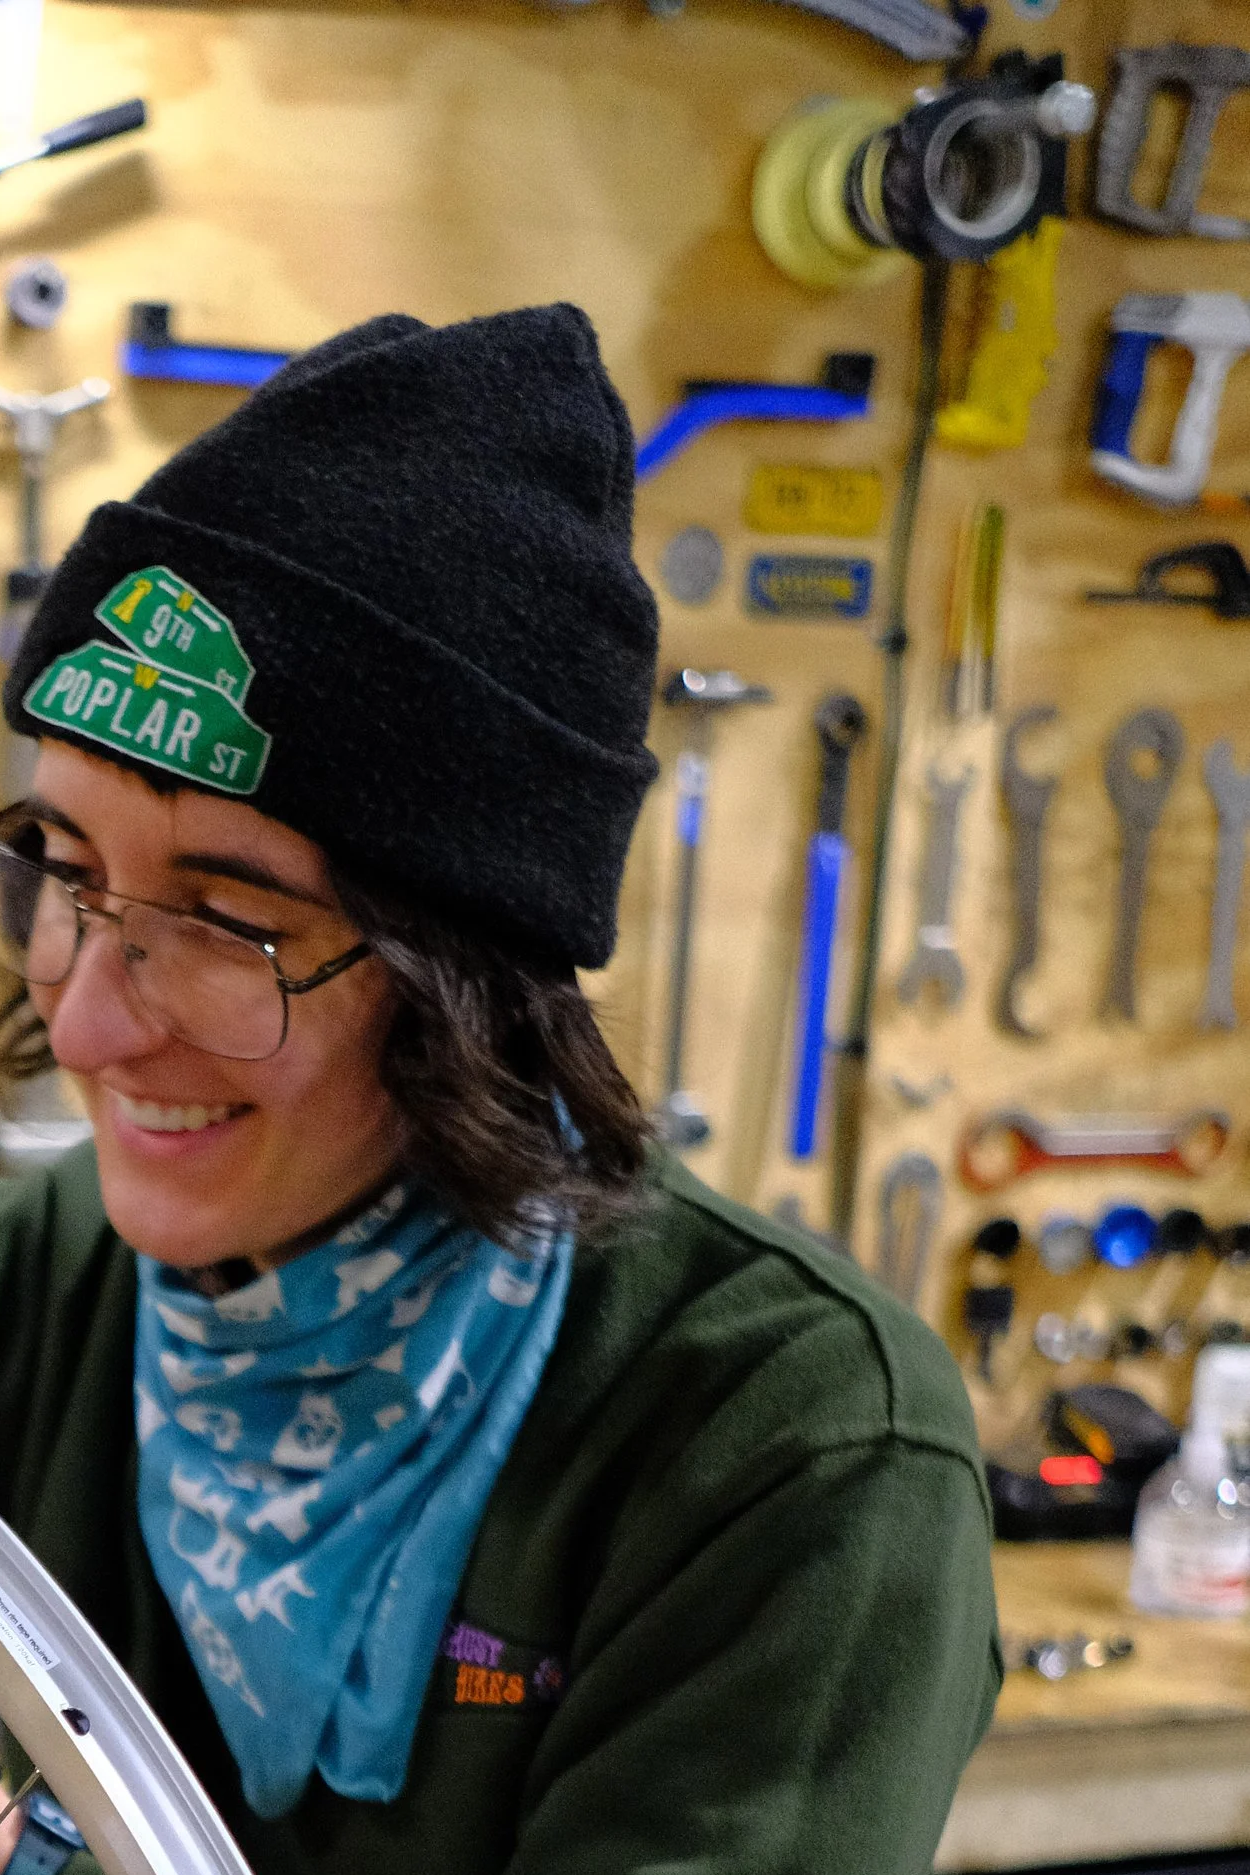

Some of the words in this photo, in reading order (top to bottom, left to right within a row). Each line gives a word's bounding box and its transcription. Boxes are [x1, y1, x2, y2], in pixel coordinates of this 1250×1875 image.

[143, 604, 197, 653] 9TH
[41, 665, 202, 762] POPLAR
[209, 741, 248, 780] ST
[17, 1623, 30, 1639] tape
[29, 1638, 52, 1665] required
